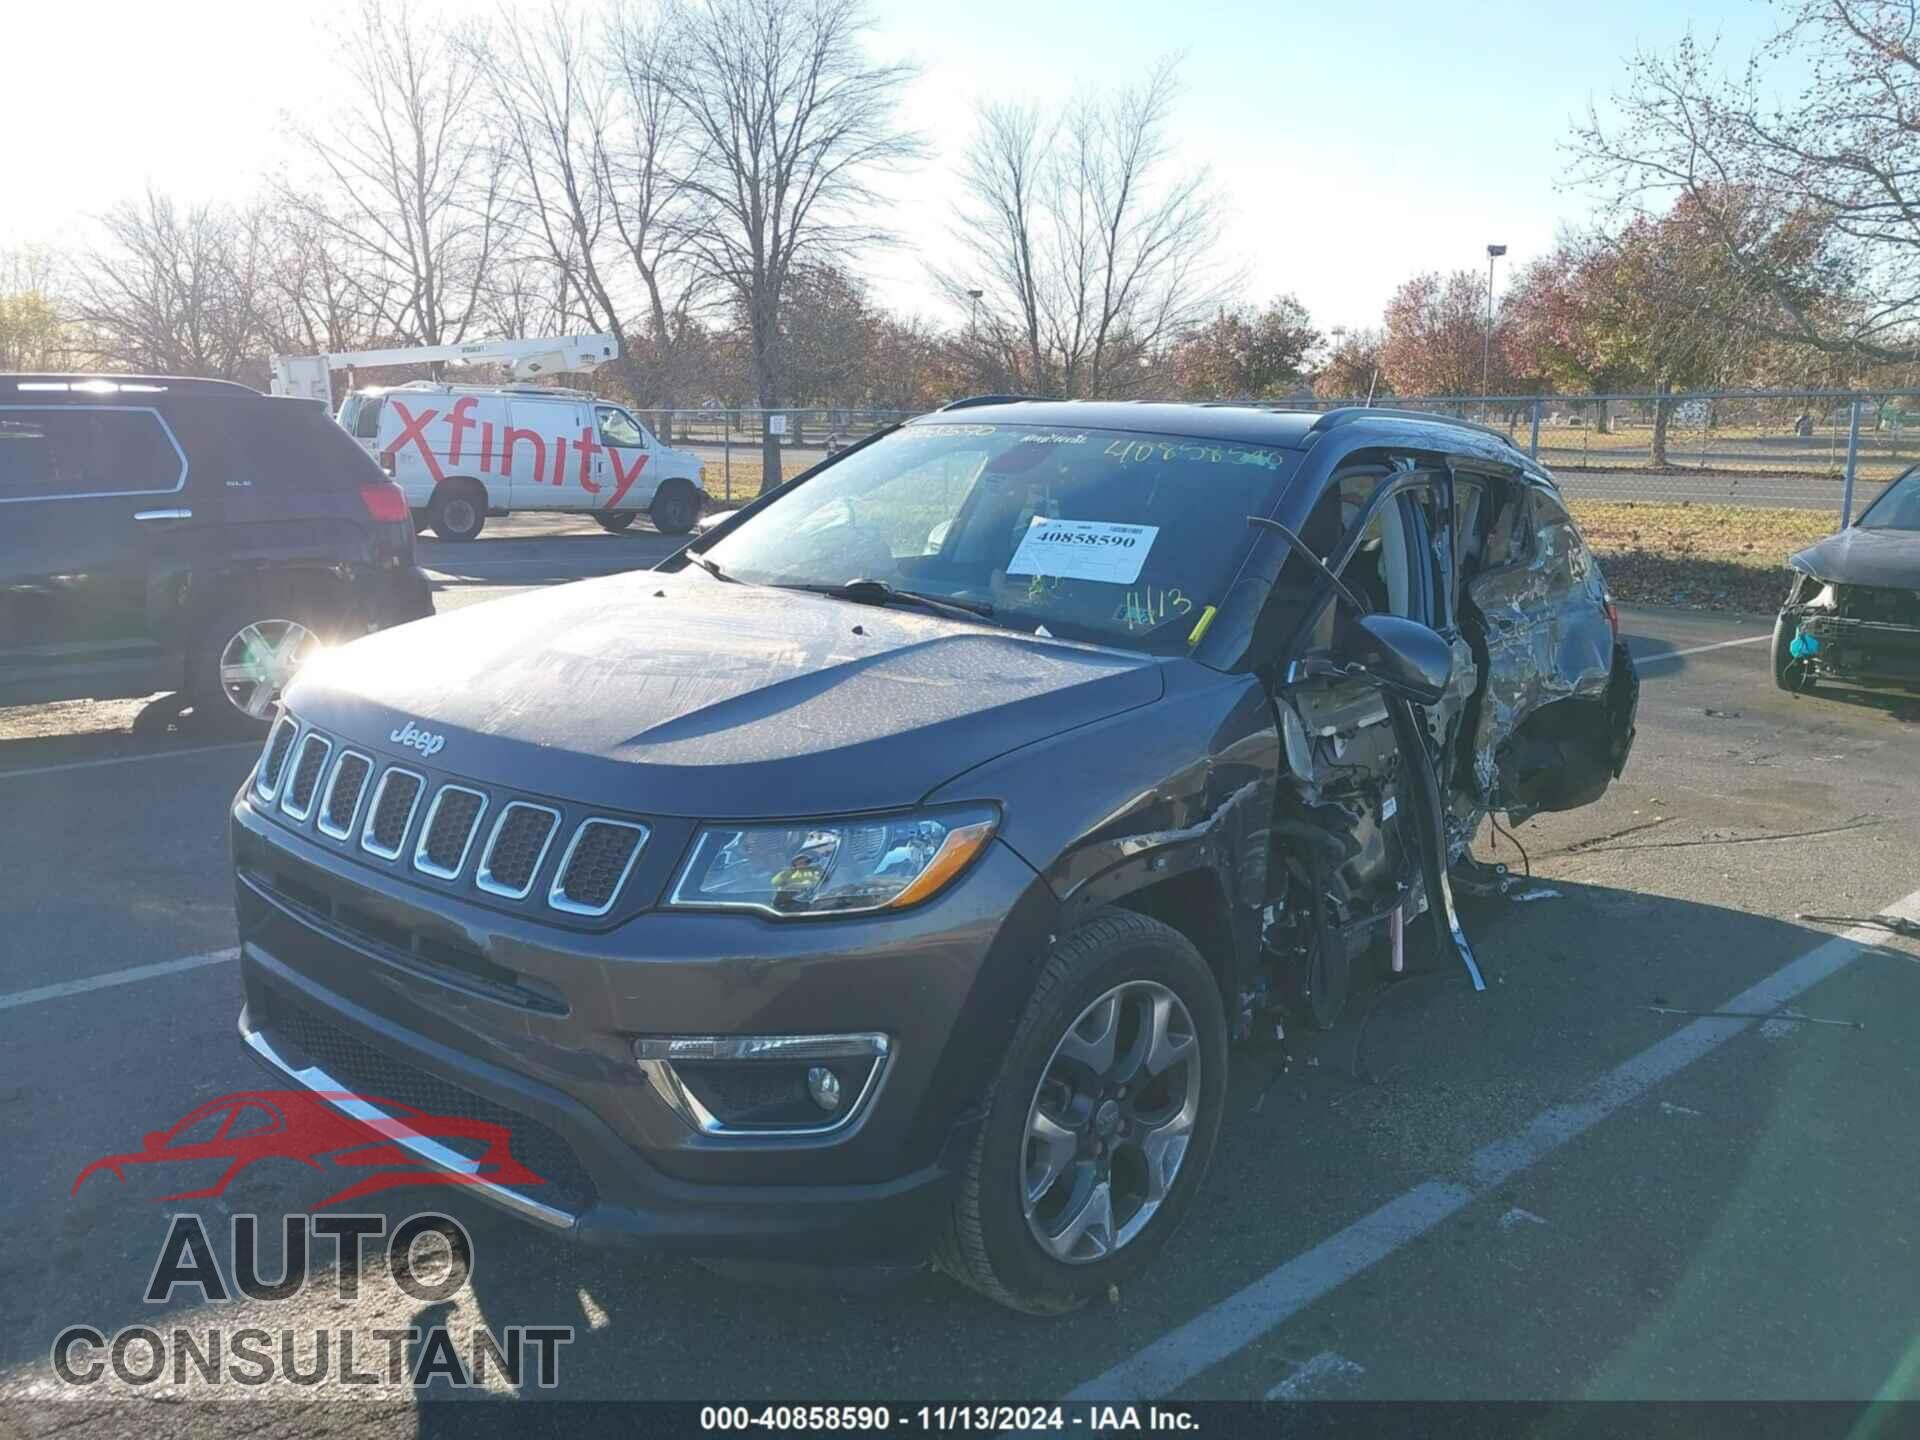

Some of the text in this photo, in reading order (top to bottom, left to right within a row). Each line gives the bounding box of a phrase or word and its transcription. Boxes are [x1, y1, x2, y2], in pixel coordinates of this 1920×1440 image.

[386, 396, 650, 509] xfinity
[1037, 530, 1136, 549] 40858590
[390, 720, 446, 758] Jeep
